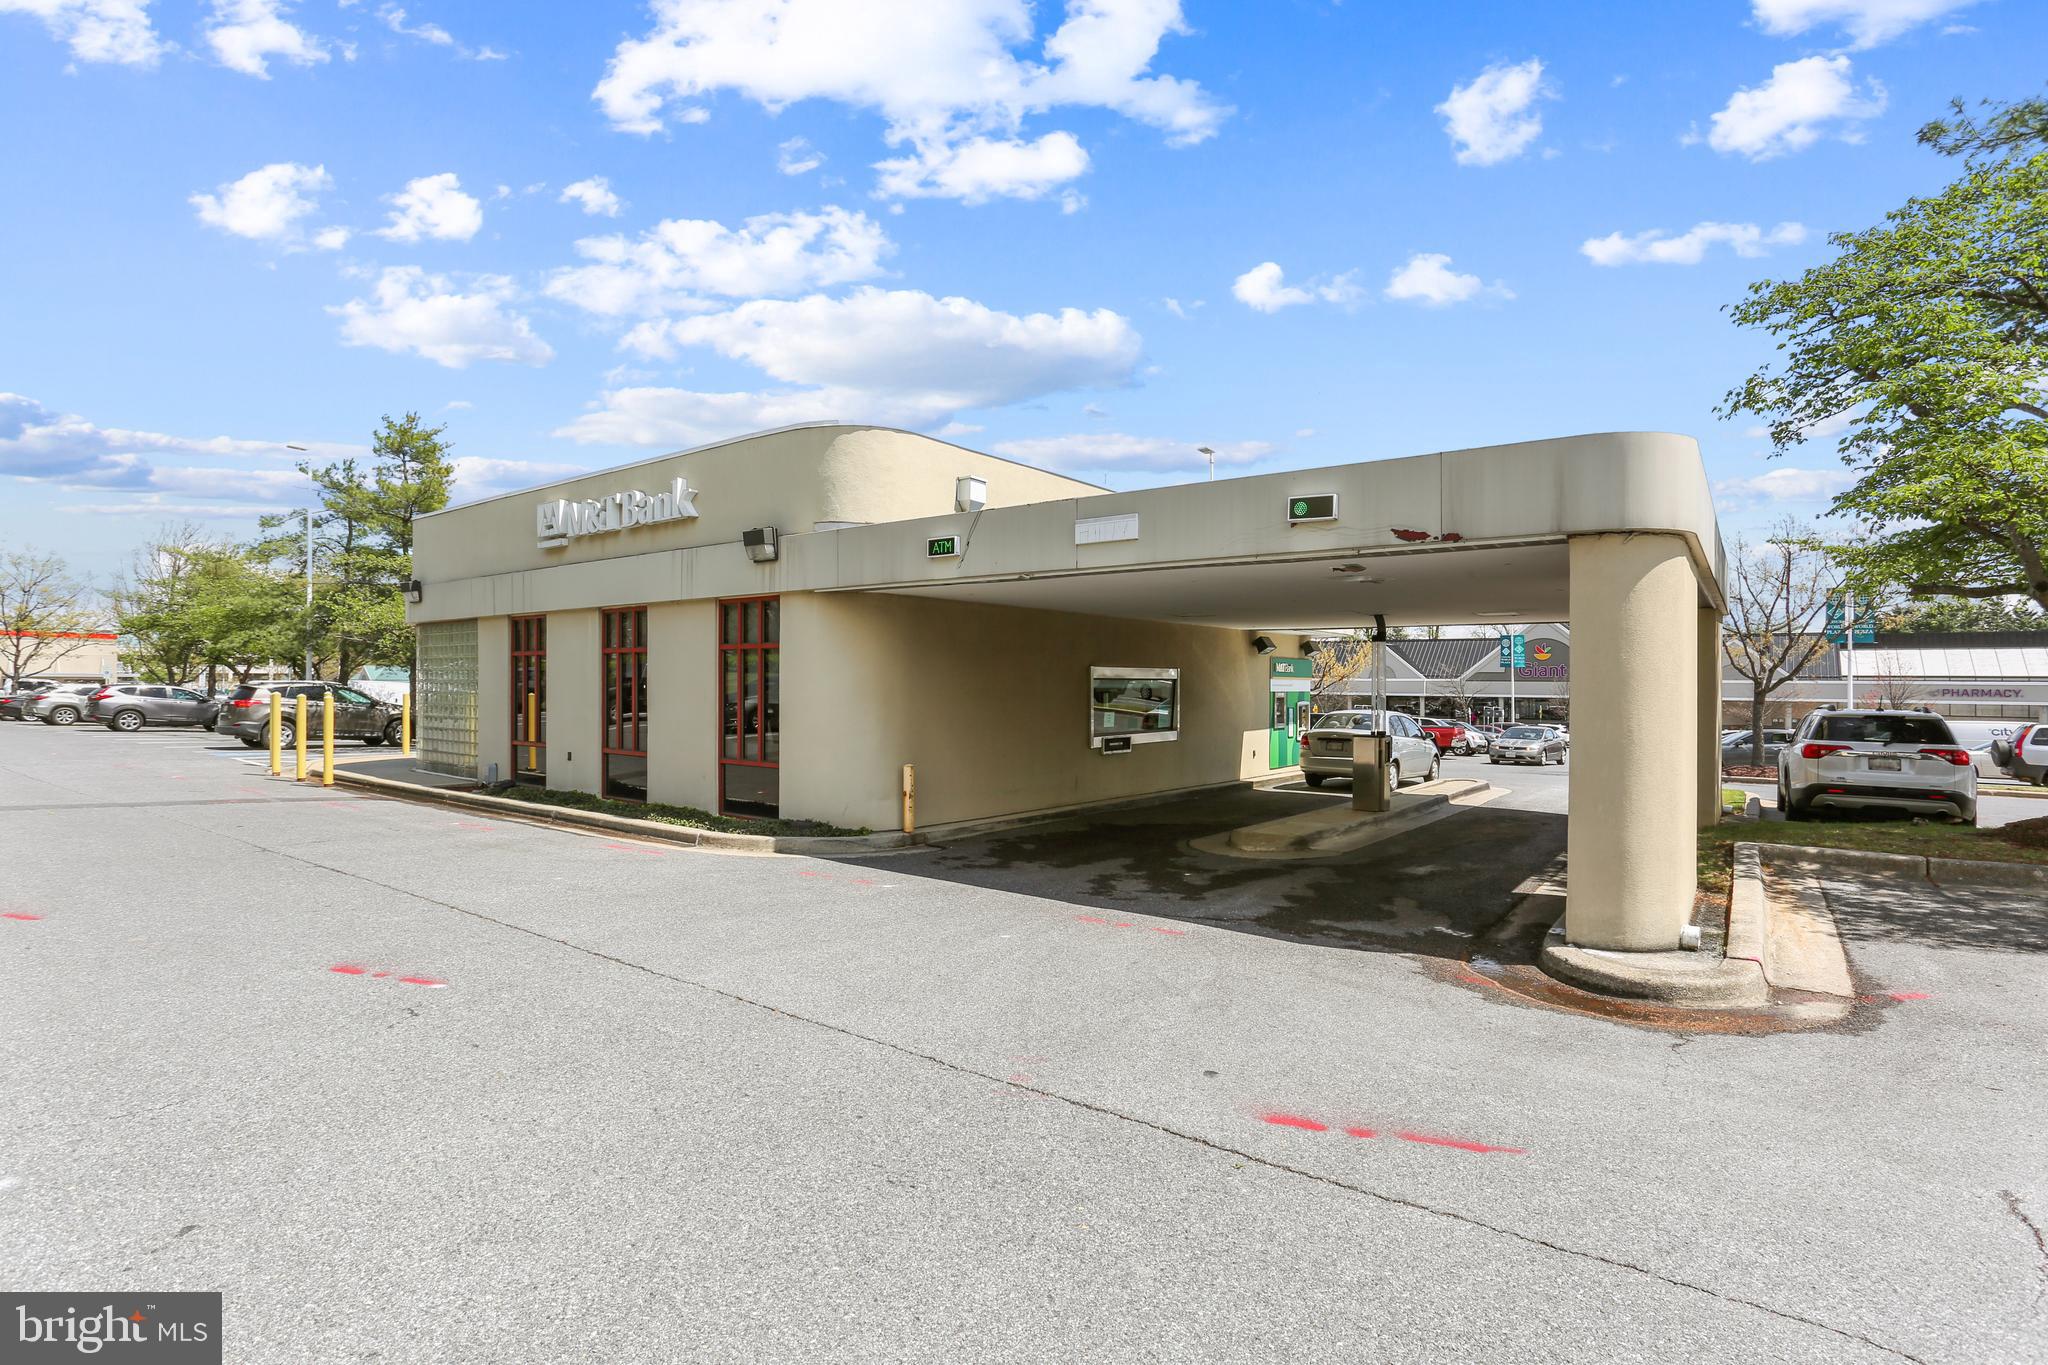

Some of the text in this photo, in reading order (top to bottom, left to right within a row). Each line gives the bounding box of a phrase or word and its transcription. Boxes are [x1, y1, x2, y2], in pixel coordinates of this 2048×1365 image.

[621, 476, 699, 528] Bank
[932, 540, 952, 554] ATM
[1518, 661, 1567, 678] Giant
[1942, 688, 2022, 698] PHARMACY
